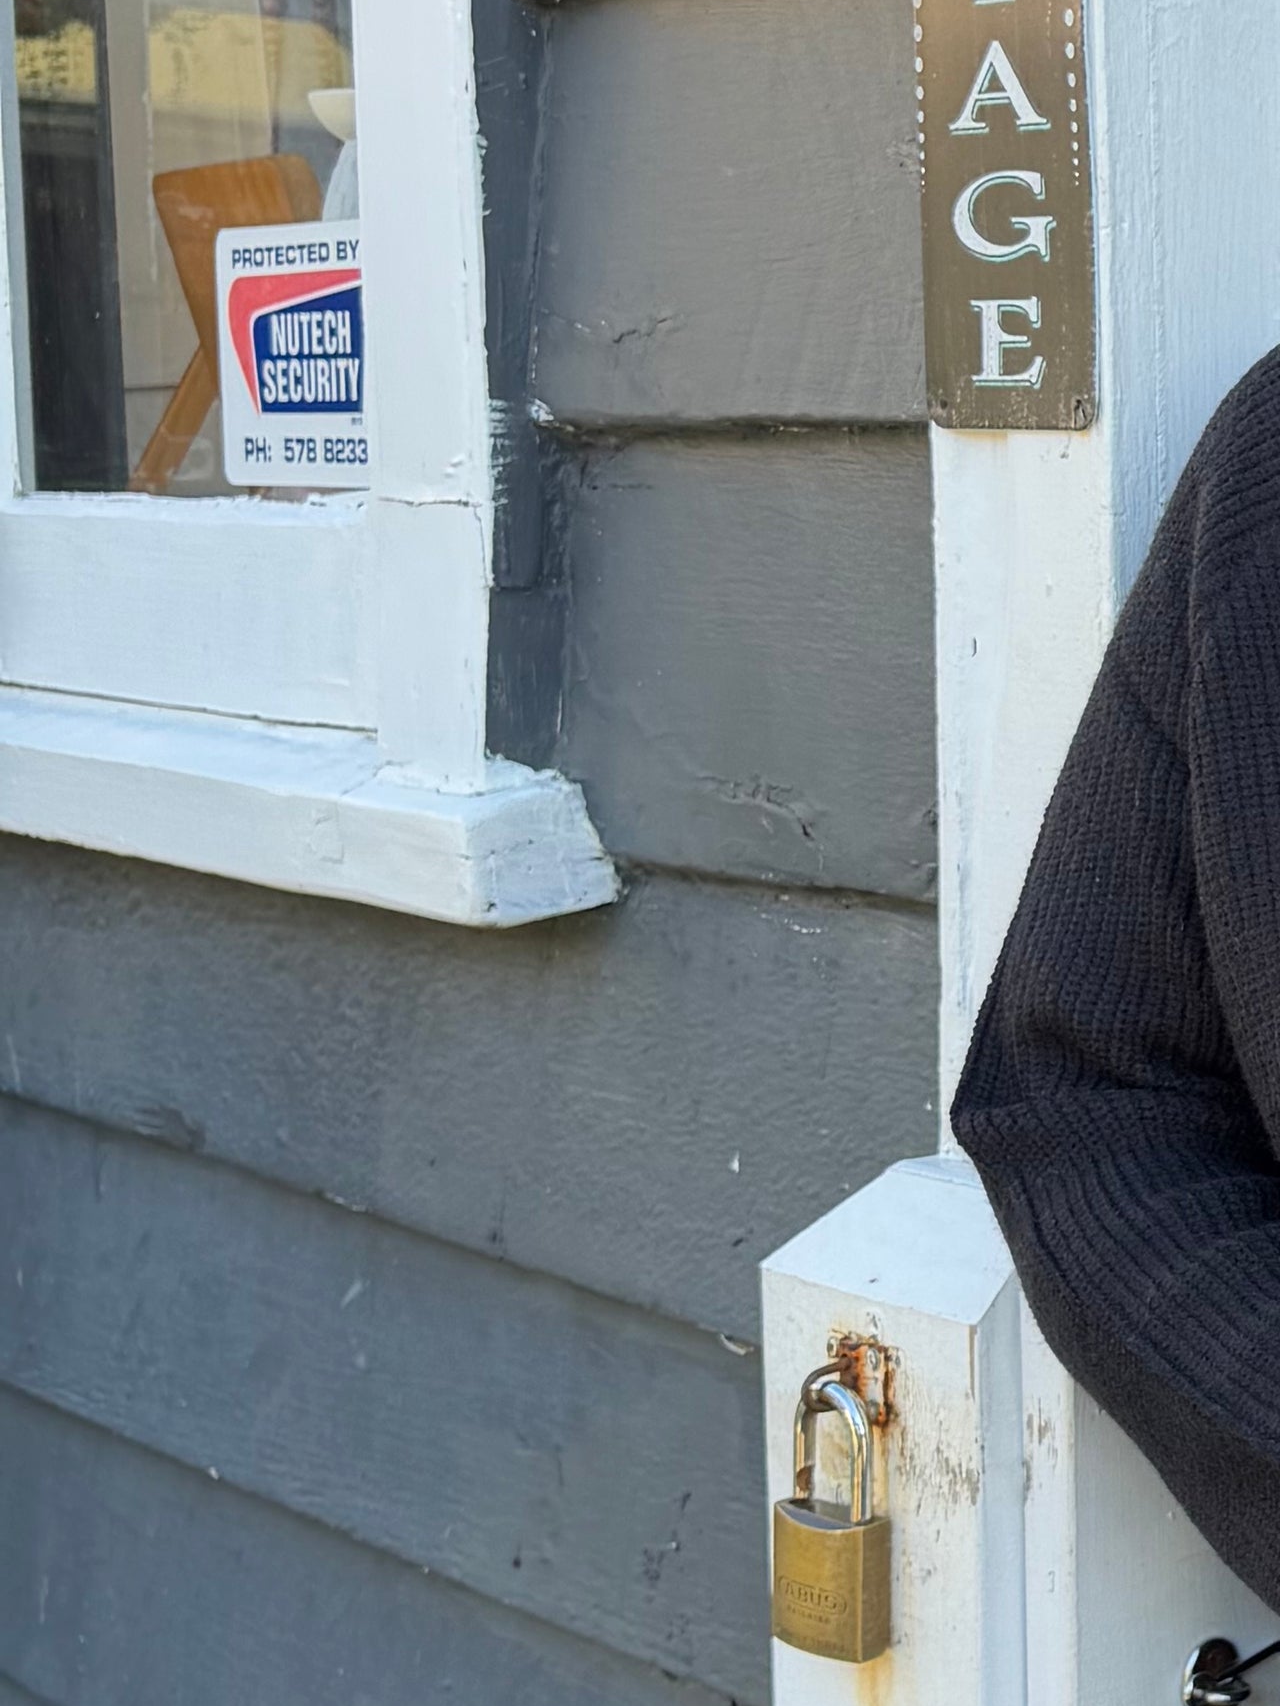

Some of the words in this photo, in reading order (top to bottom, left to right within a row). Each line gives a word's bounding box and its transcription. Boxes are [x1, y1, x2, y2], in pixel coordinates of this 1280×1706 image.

[232, 242, 330, 269] PROTECTED
[336, 239, 360, 261] BY
[271, 310, 351, 356] NUTECH
[262, 358, 360, 404] SECURITY
[244, 437, 272, 464] PH:
[284, 437, 317, 464] 578
[323, 437, 369, 465] 8233
